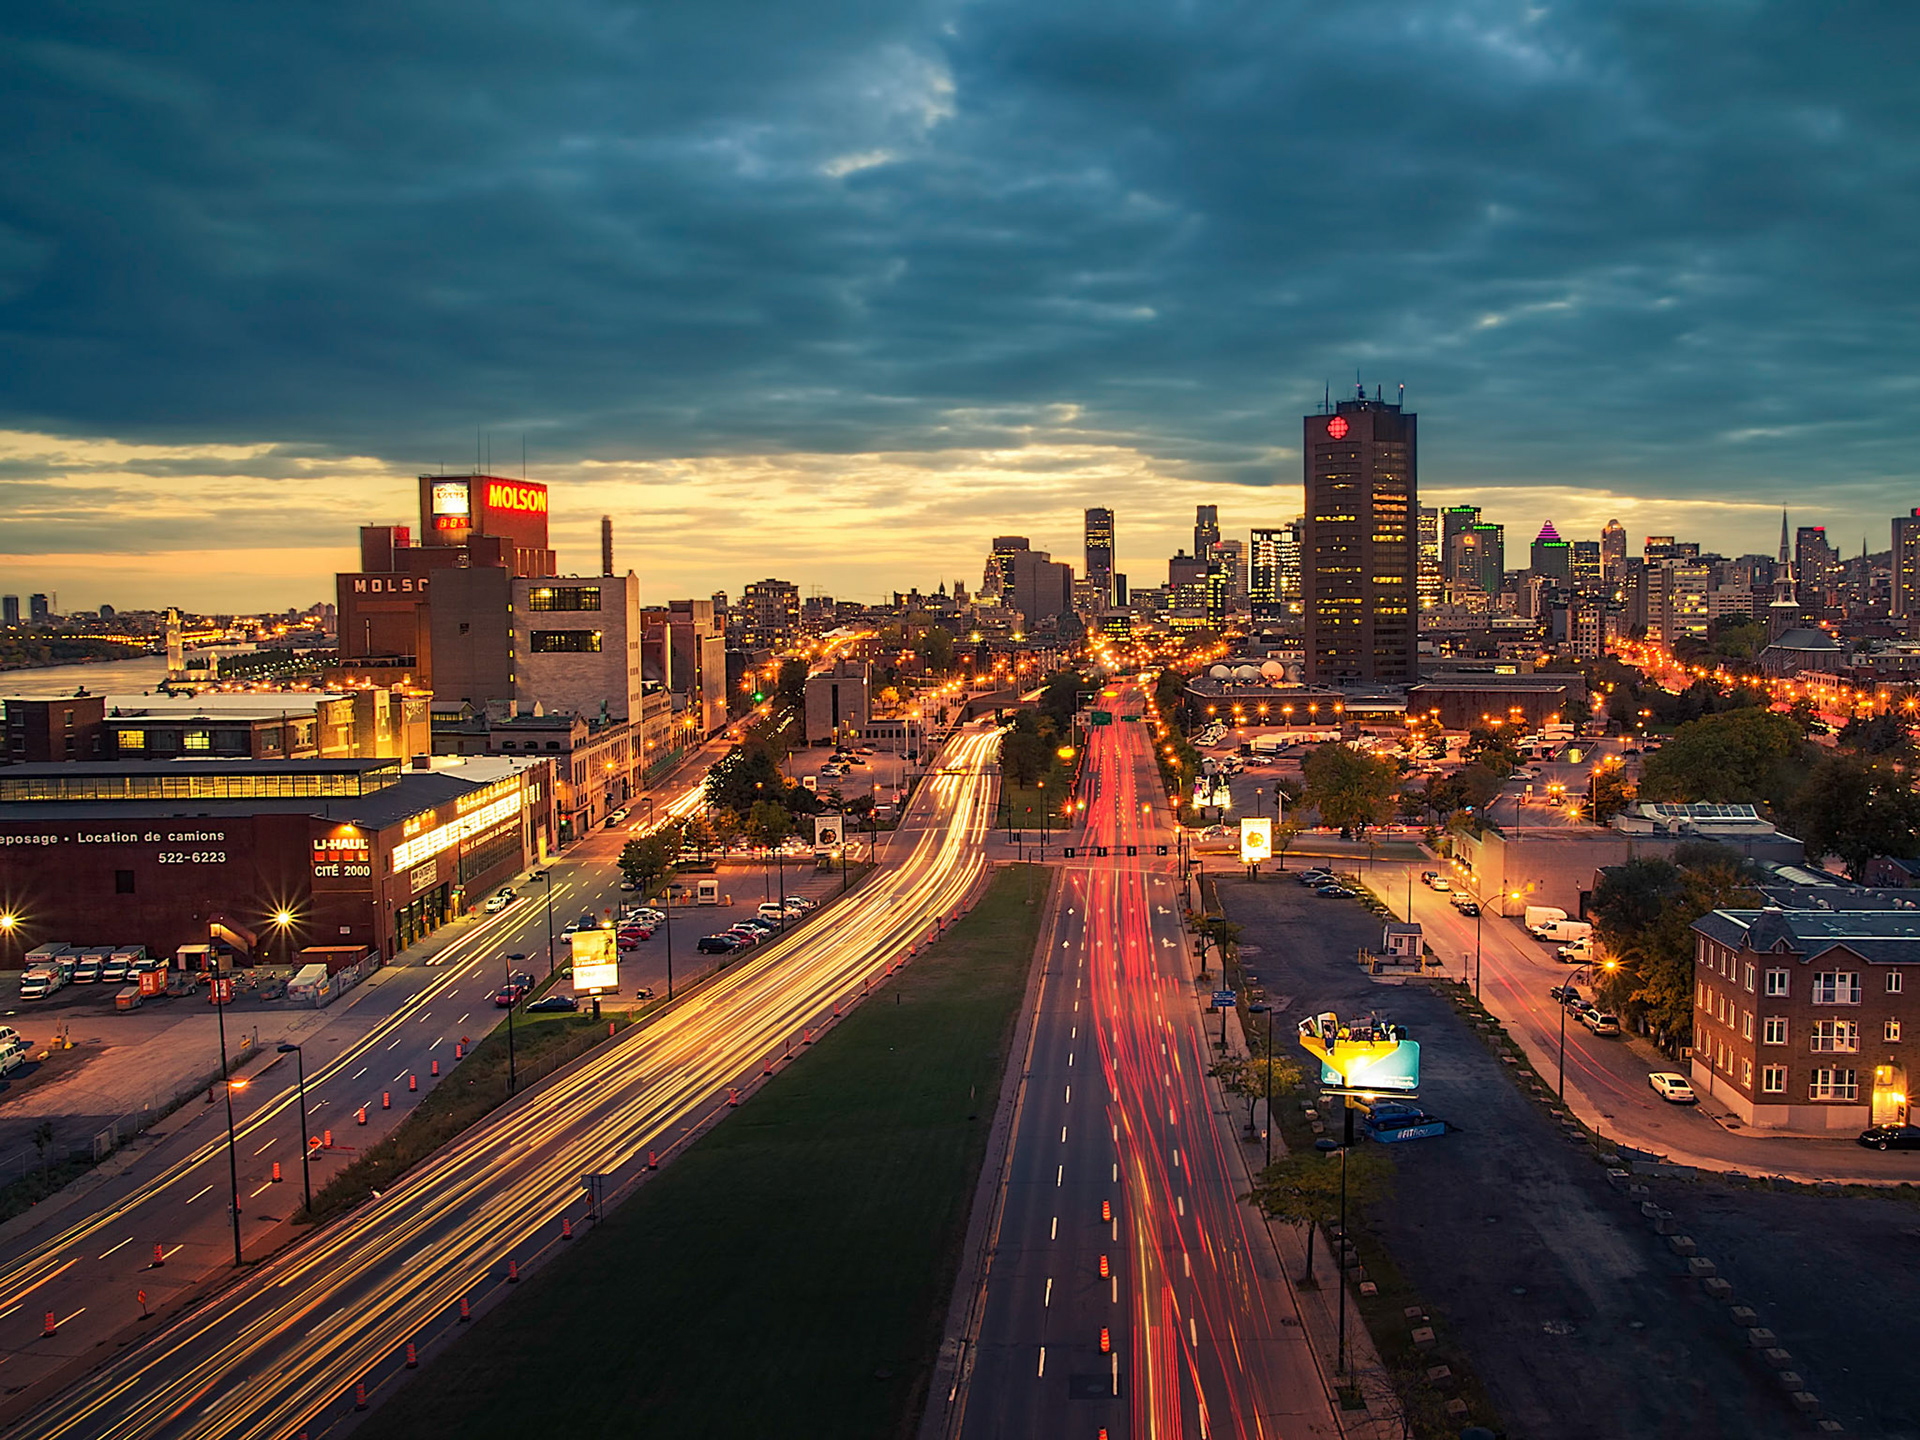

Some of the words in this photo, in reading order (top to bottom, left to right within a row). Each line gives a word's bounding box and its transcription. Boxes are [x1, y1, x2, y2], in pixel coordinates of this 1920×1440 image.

[489, 484, 547, 512] MOLSON
[77, 832, 138, 843] Location
[144, 831, 161, 842] de
[167, 830, 225, 842] camions
[313, 838, 369, 850] U-HAUL
[158, 851, 226, 863] 522-6223
[315, 864, 339, 877] CITÉ
[344, 865, 370, 876] 2000
